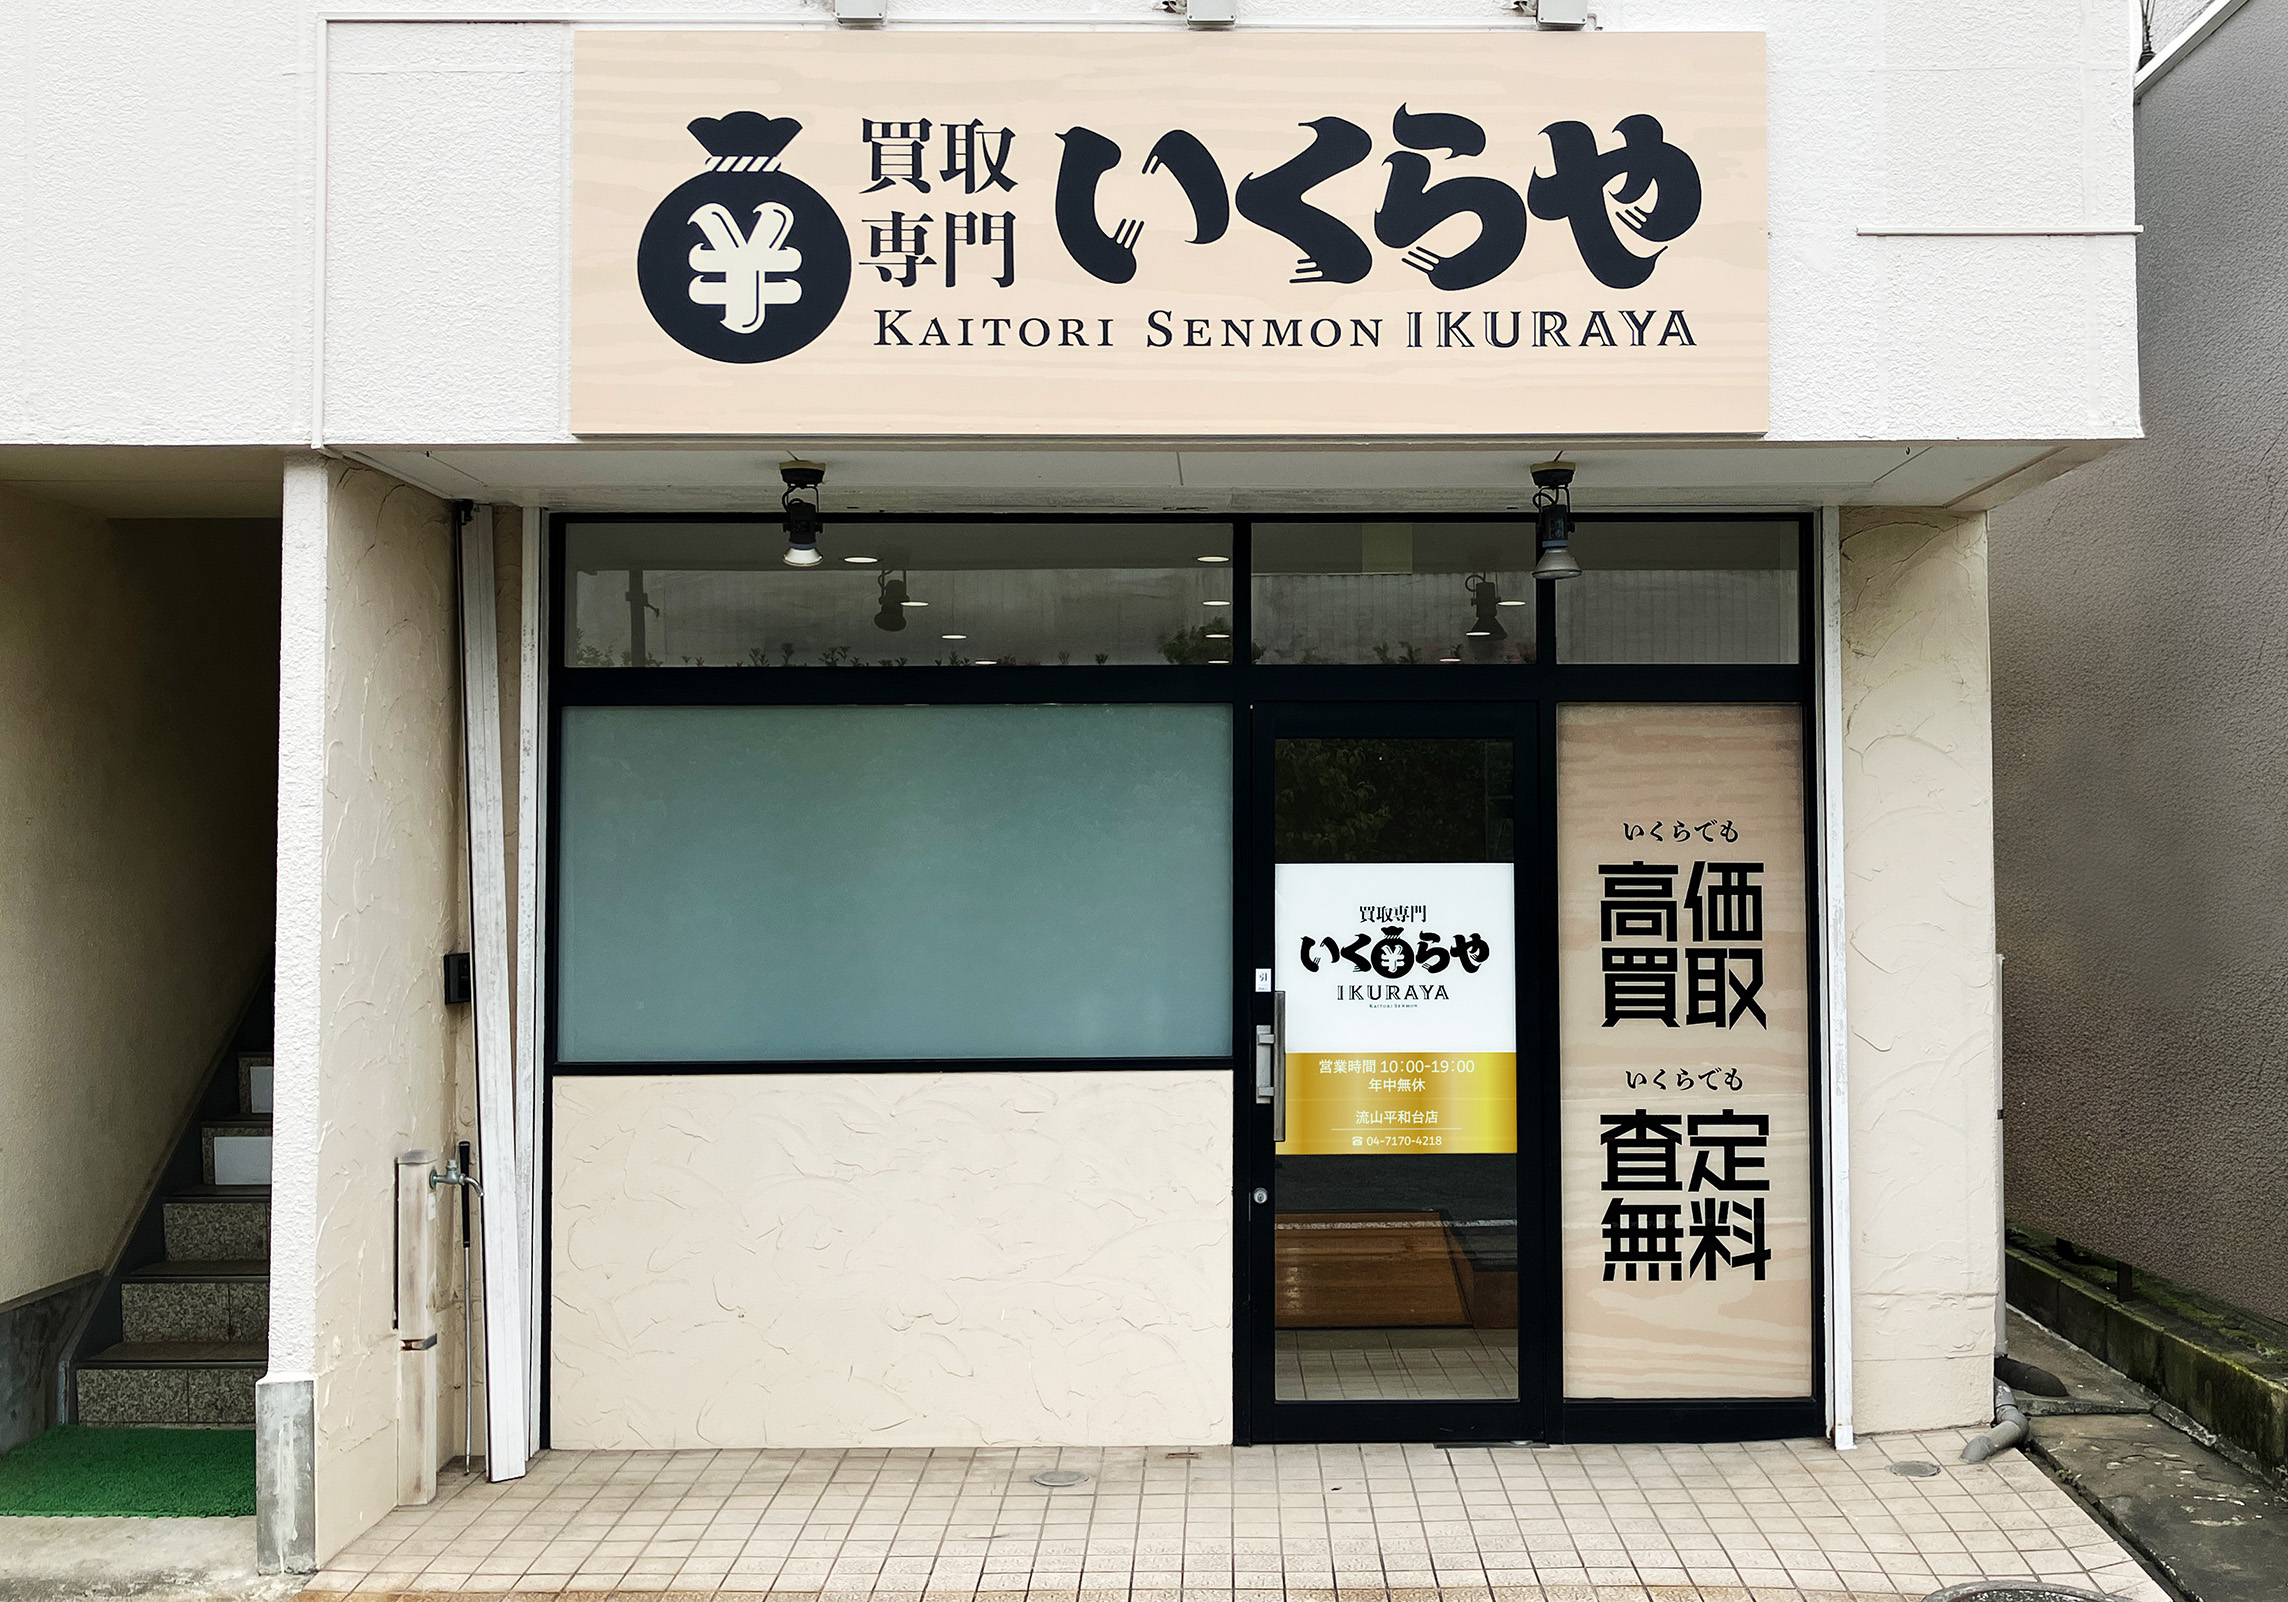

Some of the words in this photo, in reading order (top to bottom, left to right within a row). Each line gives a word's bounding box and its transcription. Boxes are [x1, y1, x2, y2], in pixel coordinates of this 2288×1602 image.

[861, 117, 1019, 194] 買取
[1055, 102, 1702, 291] いくらや
[859, 210, 1017, 288] 専門
[873, 309, 1114, 348] KAITORI
[1146, 309, 1383, 348] SENMON
[1406, 309, 1697, 349] IKURAYA
[1622, 818, 1739, 843] いくらでも
[1359, 904, 1427, 923] 買取専門
[1598, 860, 1765, 943] 高価
[1337, 984, 1450, 1001] IKURAYA
[1601, 947, 1768, 1031] 買取
[1318, 1058, 1377, 1075] 営業時間
[1625, 1066, 1743, 1092] いくらでも
[1368, 1077, 1426, 1093] 年中無休
[1355, 1109, 1439, 1125] 流山平和台店
[1366, 1135, 1443, 1147] 04-7170-4218
[1599, 1108, 1771, 1193] 査定
[1600, 1197, 1772, 1282] 無料
